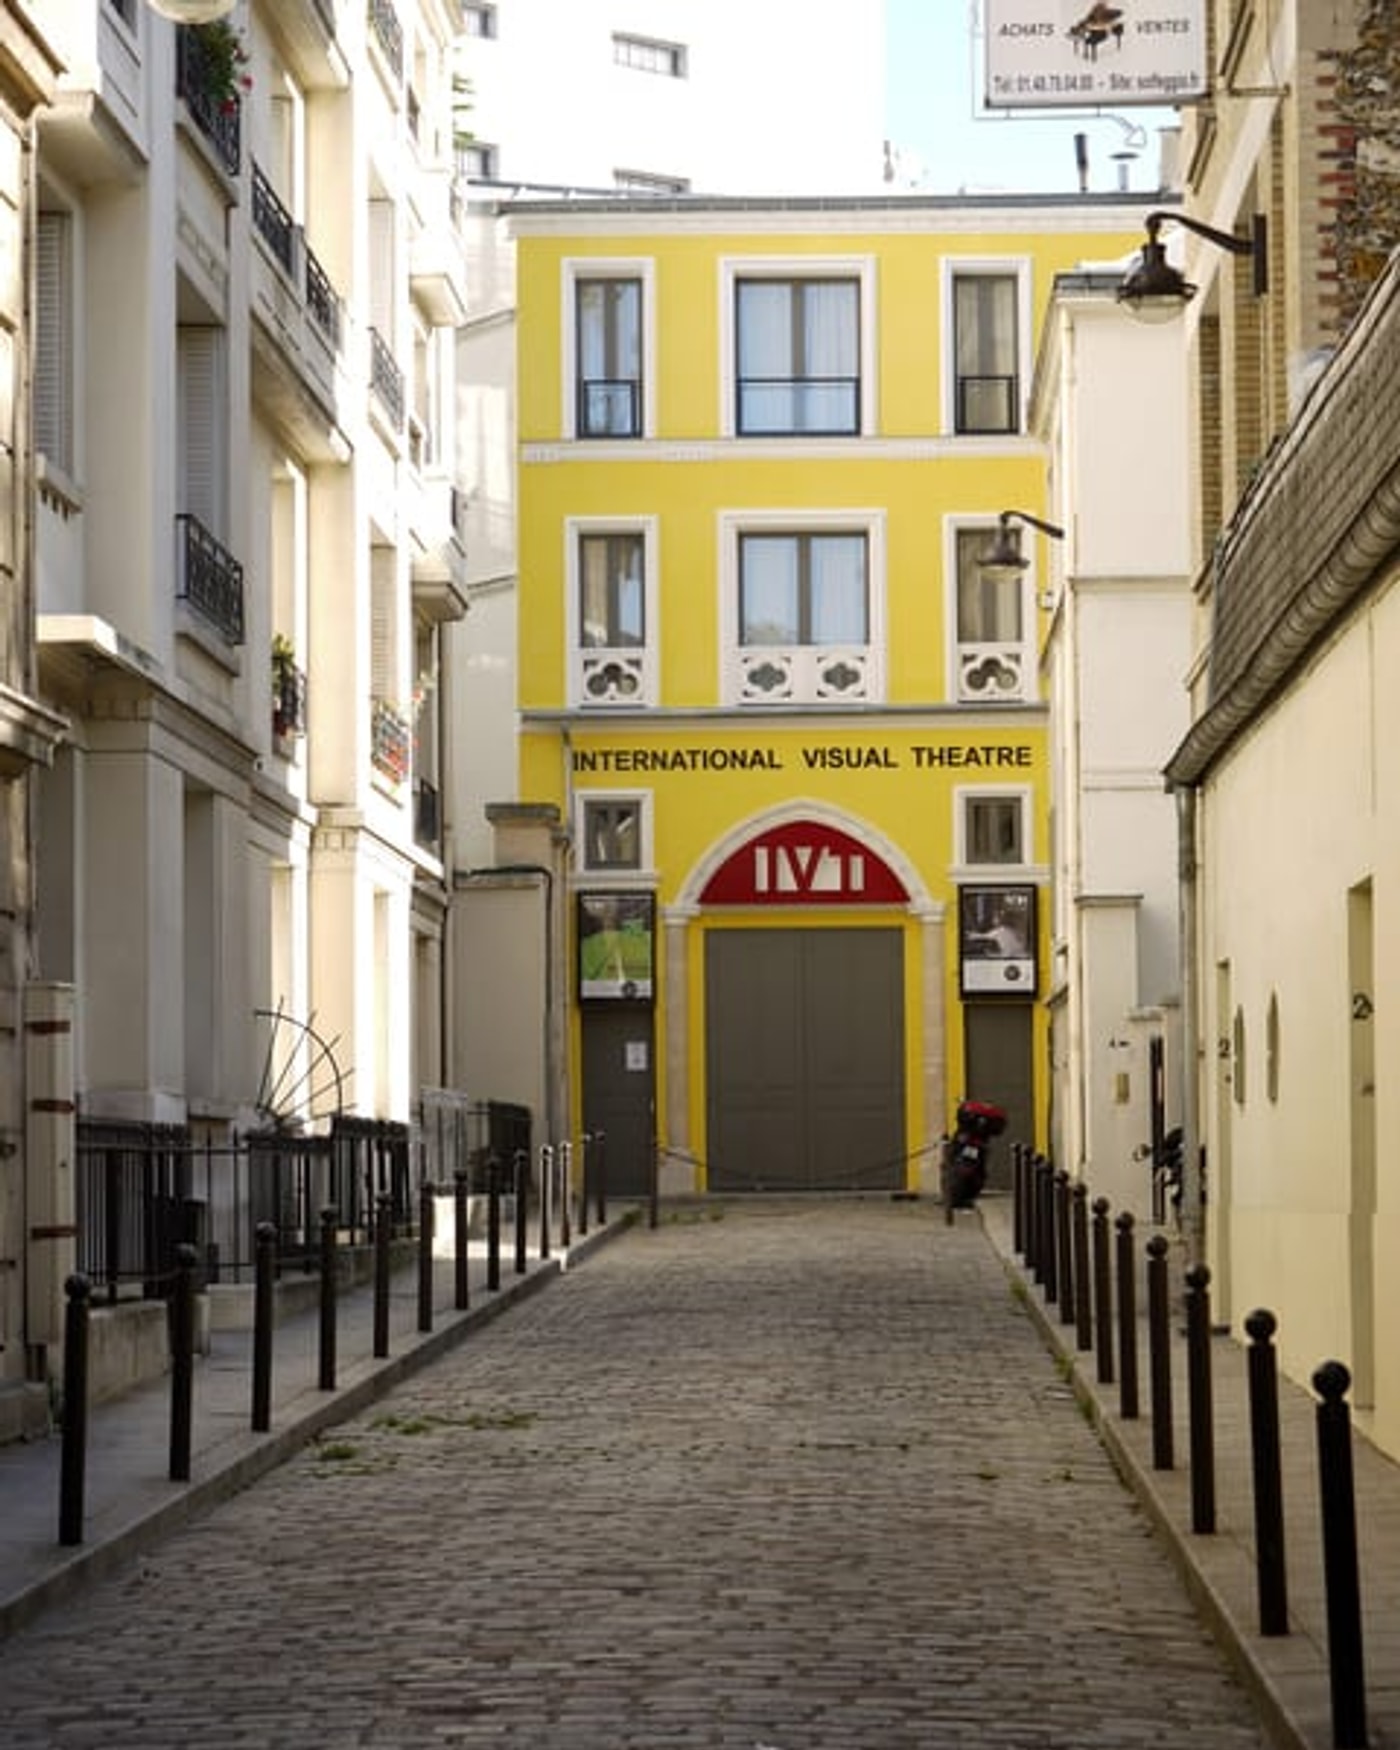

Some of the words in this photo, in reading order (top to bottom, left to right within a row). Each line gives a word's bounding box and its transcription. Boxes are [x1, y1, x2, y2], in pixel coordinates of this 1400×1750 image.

[998, 22, 1055, 37] ACHATS
[1136, 19, 1190, 34] VENTES
[572, 749, 782, 772] INTERNATIONAL
[802, 748, 897, 769] VISUAL
[911, 746, 1032, 768] THEATRE
